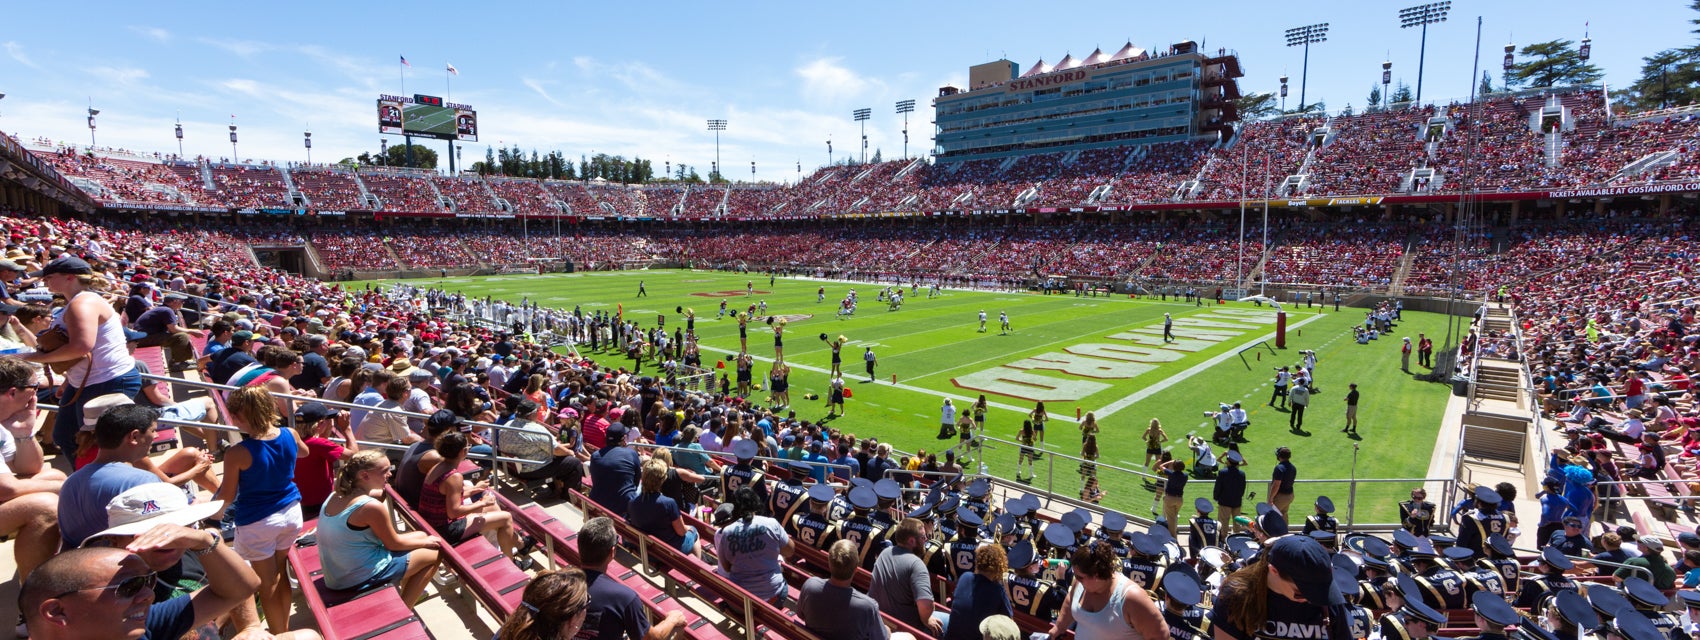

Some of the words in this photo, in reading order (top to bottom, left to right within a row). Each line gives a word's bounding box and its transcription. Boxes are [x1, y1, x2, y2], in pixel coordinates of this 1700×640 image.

[1010, 70, 1086, 91] STANFORD
[380, 94, 413, 103] STANFORD
[446, 102, 472, 111] STADIUM
[1549, 190, 1575, 198] TICKETS
[1576, 188, 1616, 197] AVAILABLE
[1616, 187, 1626, 195] AT
[1627, 183, 1700, 194] GOSTANFORD.CO
[142, 500, 160, 514] A
[727, 525, 767, 542] Aggie
[728, 536, 767, 556] Pack
[1255, 620, 1328, 639] CDAVIS
